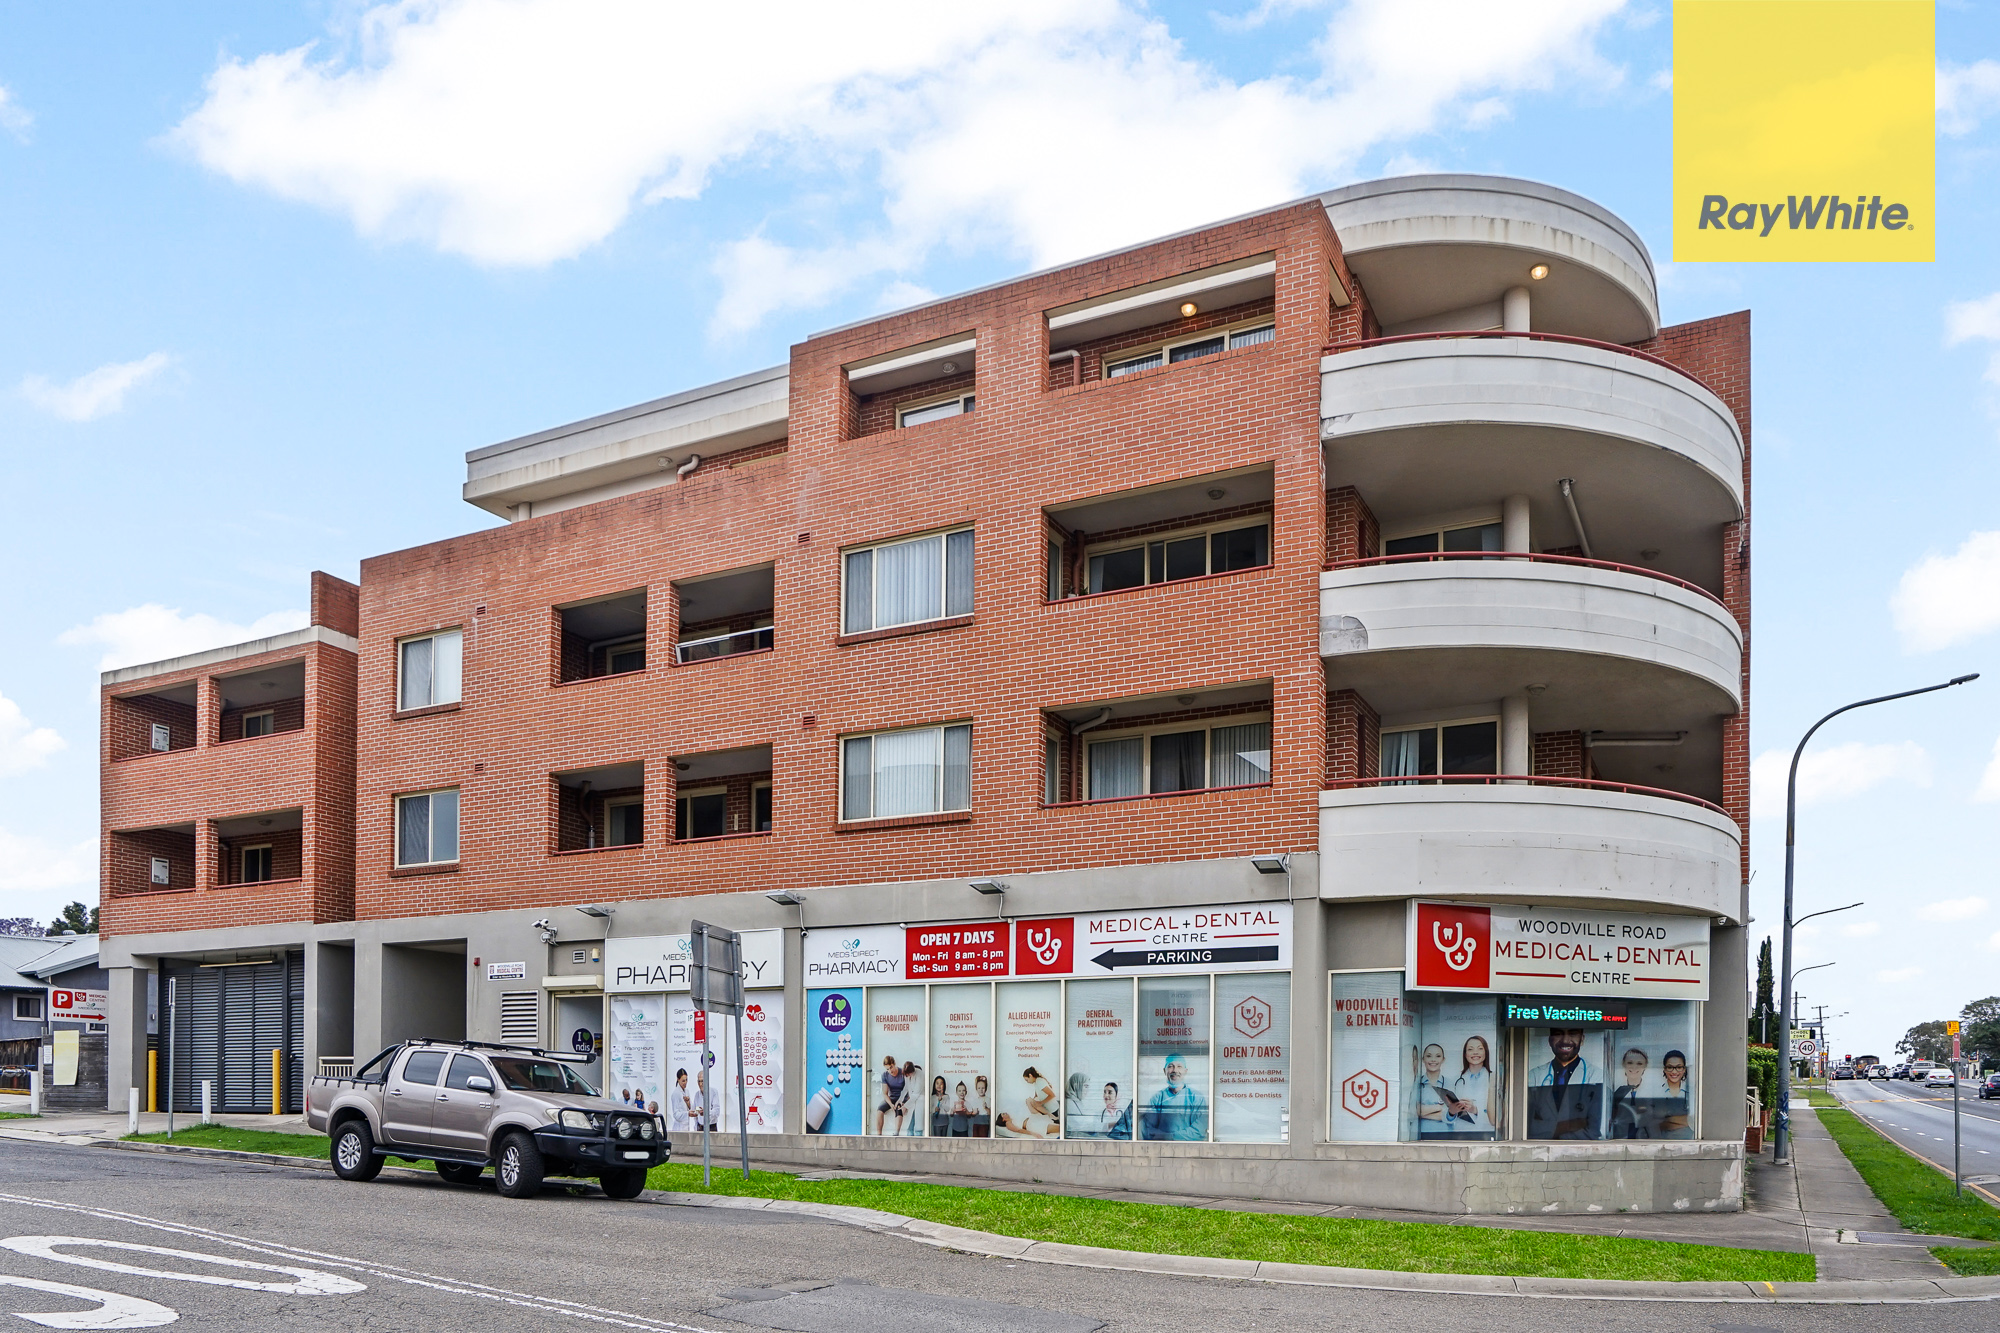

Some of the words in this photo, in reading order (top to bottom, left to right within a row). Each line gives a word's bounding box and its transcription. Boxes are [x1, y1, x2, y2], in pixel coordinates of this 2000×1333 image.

[1090, 916, 1178, 933] MEDICAL
[1195, 911, 1279, 928] DENTAL
[1518, 919, 1615, 937] WOODVILLE
[1622, 925, 1666, 939] ROAD
[920, 933, 950, 946] OPEN
[953, 932, 961, 945] 7
[963, 930, 995, 944] DAYS
[1152, 932, 1208, 944] CENTRE
[662, 953, 687, 961] MEDS
[912, 953, 930, 961] Mon
[937, 951, 949, 960] Fri
[955, 951, 960, 960] 8
[962, 951, 975, 959] am
[982, 949, 988, 958] 8
[990, 950, 1004, 960] pm
[1147, 950, 1212, 963] PARKING
[1495, 940, 1600, 962] MEDICAL
[1617, 946, 1701, 967] DENTAL
[617, 960, 768, 985] PHARY
[809, 959, 899, 975] PHARMACY
[932, 963, 949, 972] Sun
[955, 962, 960, 971] 9
[962, 963, 975, 971] am
[982, 961, 988, 970] 8
[990, 962, 1004, 972] pm
[1571, 971, 1631, 985] CENTRE
[57, 993, 68, 1006] P
[1335, 998, 1399, 1011] WOODVILLE
[827, 999, 833, 1013] I
[1155, 1008, 1171, 1016] BULK
[1173, 1008, 1194, 1016] BILLED
[876, 1014, 918, 1022] REHABILITATION
[950, 1013, 973, 1021] DENTIST
[1008, 1012, 1027, 1020] ALLIED
[1029, 1011, 1051, 1019] HEALTH
[1086, 1010, 1113, 1018] GENERAL
[1508, 1004, 1539, 1019] Free
[1542, 1005, 1603, 1021] Vaccines
[824, 1014, 846, 1026] ndis
[1078, 1019, 1122, 1027] PRACTITIONER
[1164, 1018, 1185, 1026] MINOR
[1346, 1014, 1354, 1026] &
[1357, 1013, 1399, 1026] DENTAL
[884, 1023, 910, 1031] PROVIDER
[1157, 1028, 1192, 1036] SURGERIES
[575, 1042, 590, 1051] ndis
[1223, 1046, 1247, 1058] OPEN
[1249, 1046, 1255, 1057] 7
[1257, 1046, 1281, 1057] DAYS
